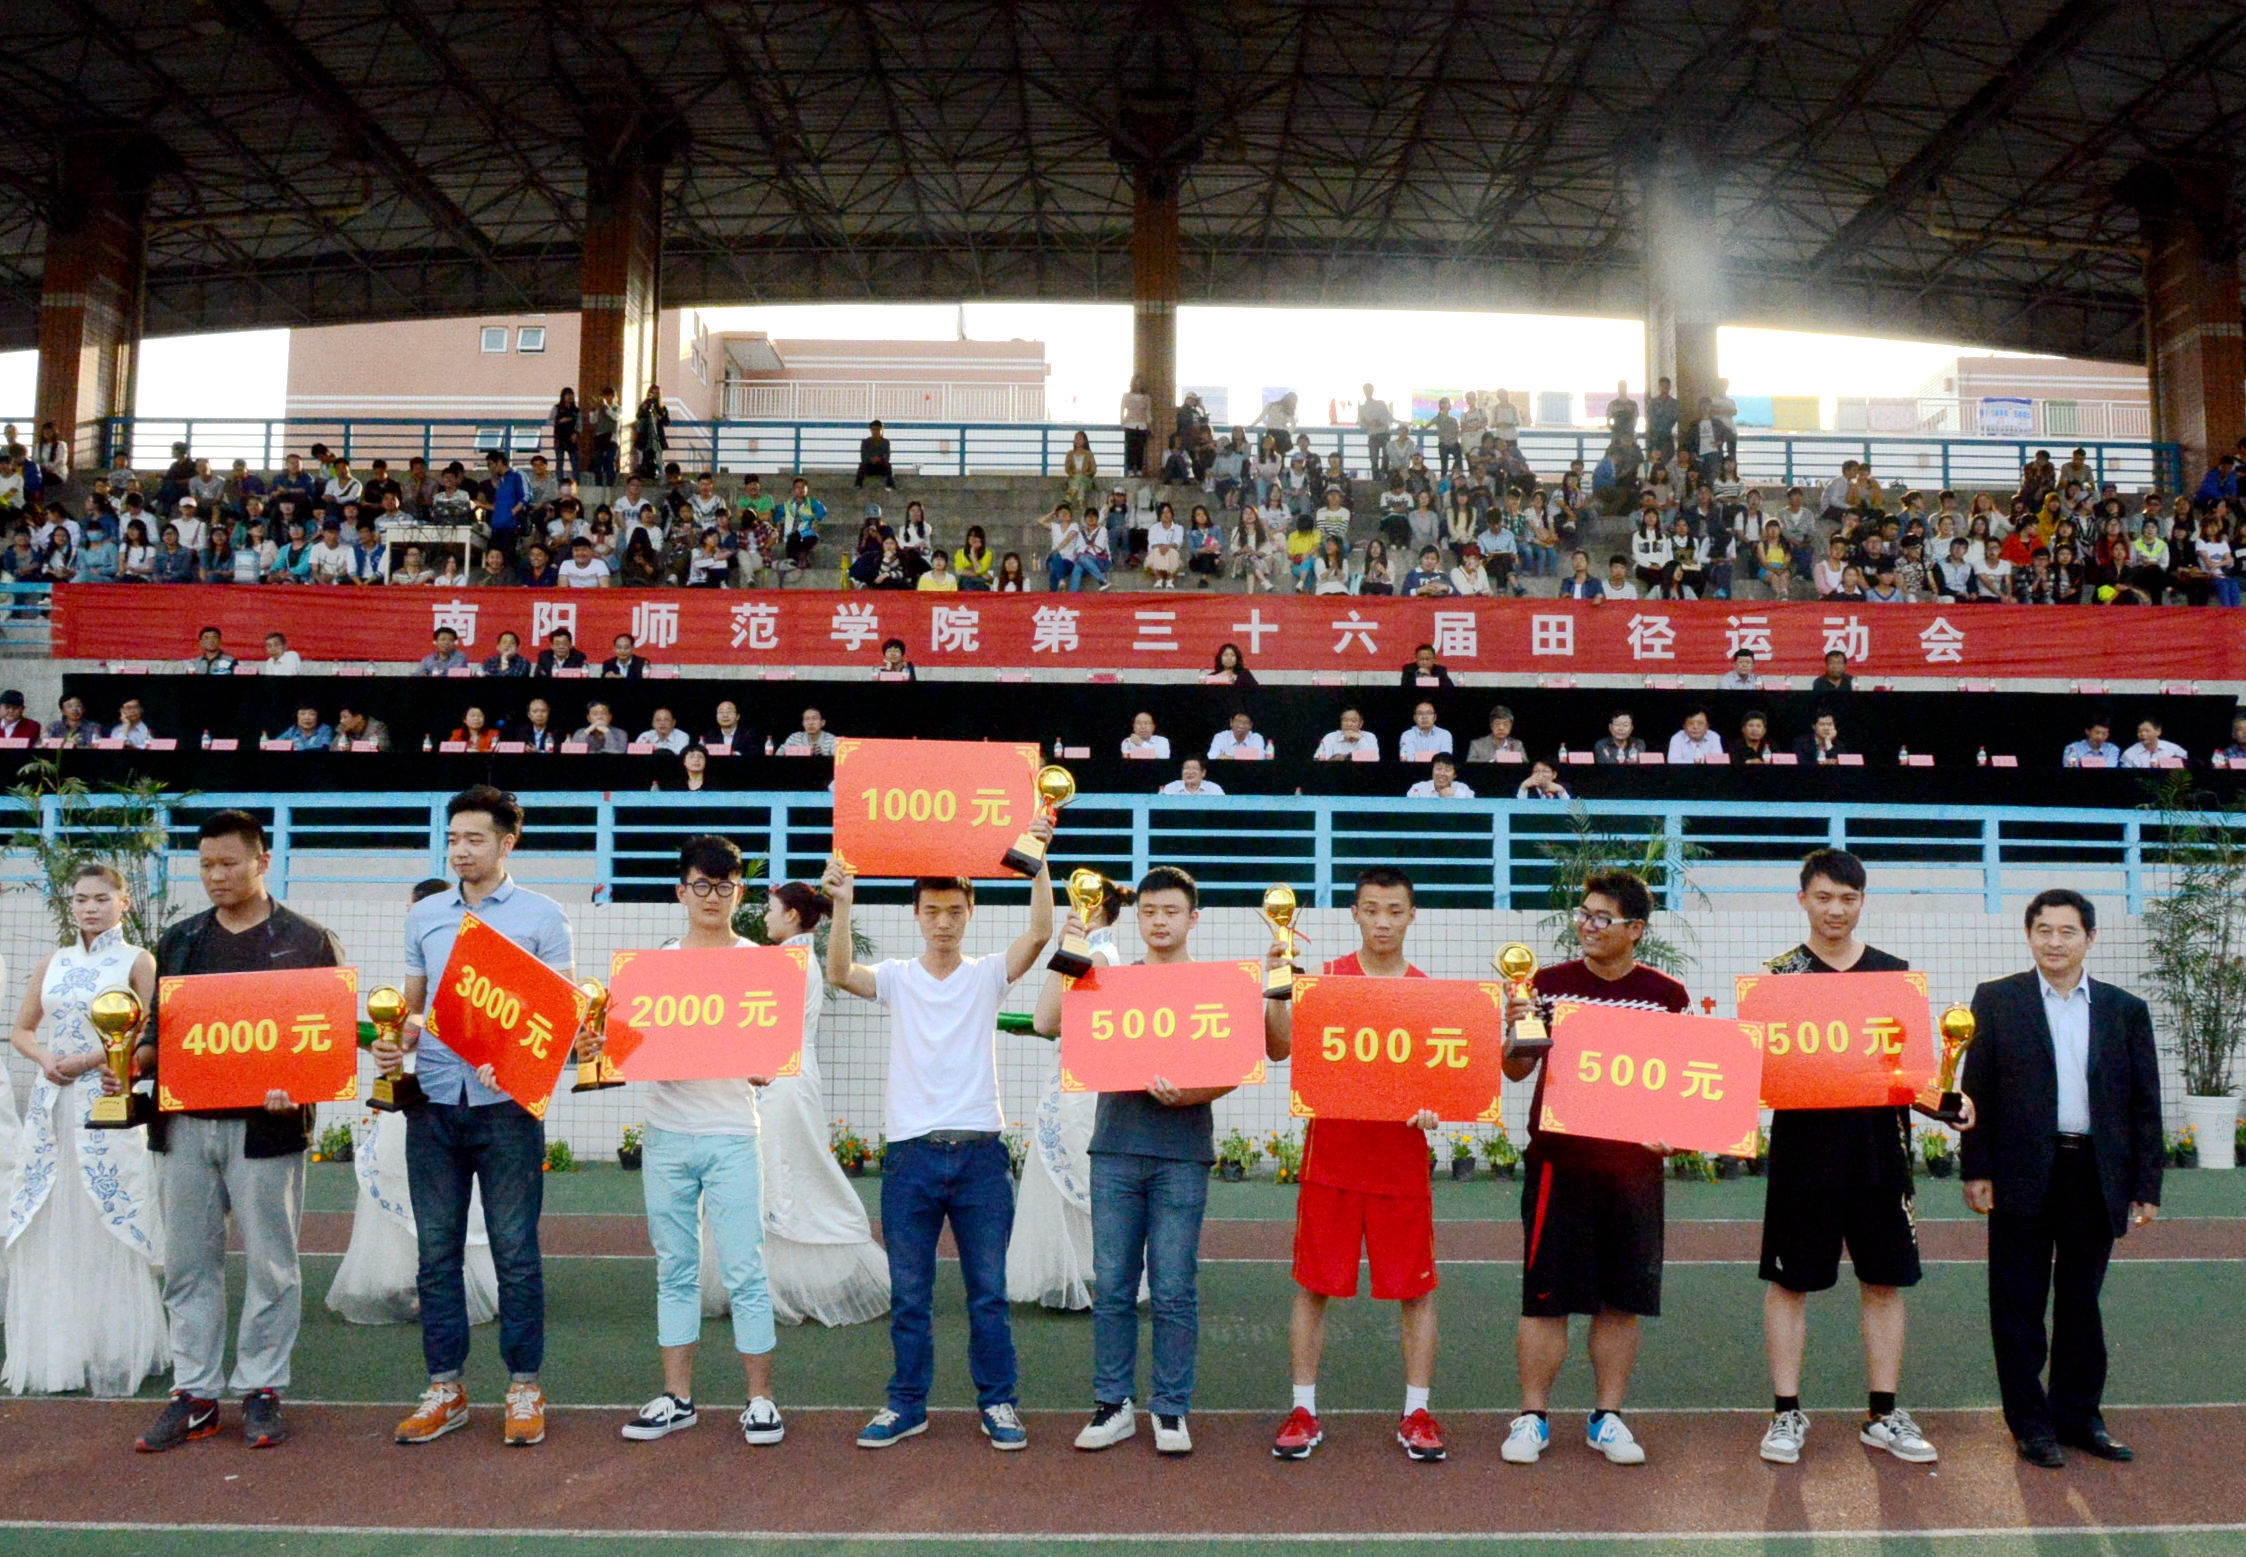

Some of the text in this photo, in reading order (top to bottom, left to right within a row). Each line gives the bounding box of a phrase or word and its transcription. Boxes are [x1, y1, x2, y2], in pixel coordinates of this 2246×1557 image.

[431, 600, 1966, 663] 南阳师范学院第三十六届田径运动会
[861, 789, 1012, 827] 1000 元
[455, 965, 553, 1060] 3000 元
[629, 991, 778, 1028] 2000 元
[1093, 1004, 1232, 1041] 500 元
[182, 1014, 332, 1056] 4000 元
[1322, 1028, 1470, 1069] 500 元
[1769, 1017, 1904, 1056] 500 元
[1578, 1051, 1725, 1101] 500 元
